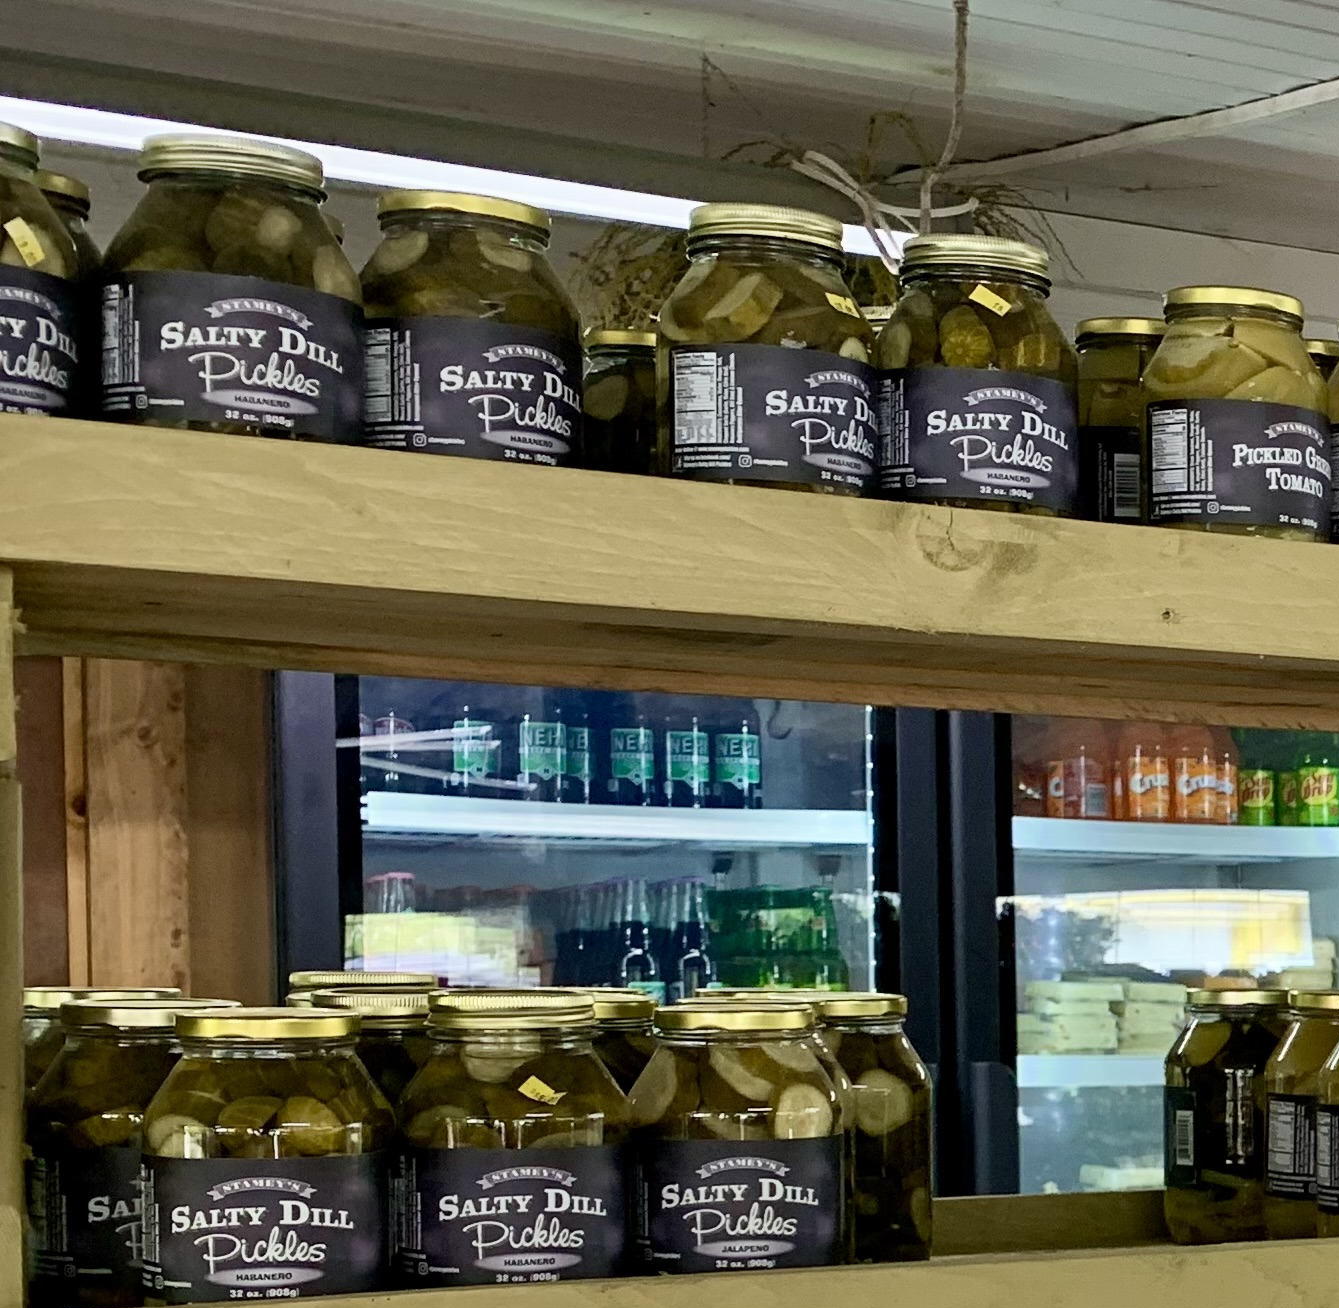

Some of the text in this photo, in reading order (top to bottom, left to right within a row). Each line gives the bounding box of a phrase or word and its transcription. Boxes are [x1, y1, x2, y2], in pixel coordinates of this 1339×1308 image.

[161, 321, 342, 374] SALTY DILL
[0, 343, 69, 390] ickles
[188, 352, 320, 397] Pickles
[440, 365, 582, 413] SALTY DILL
[765, 389, 848, 416] SALTY
[468, 394, 572, 436] Pickles
[927, 409, 1069, 450] SALTY DILL
[791, 417, 874, 459] Pickles
[949, 433, 1053, 472] Pickles
[1232, 444, 1302, 467] PICKLED
[1266, 468, 1323, 498] TOMATO
[491, 1168, 563, 1181] STAMEY'S
[709, 1158, 777, 1171] STAMEY'S
[222, 1179, 301, 1193] STAMEY'S
[661, 1177, 819, 1210] SALTY DILL
[88, 1195, 142, 1223] SAL
[171, 1200, 354, 1234] SALTY DILL
[438, 1188, 607, 1221] SALTY DILL
[462, 1213, 585, 1260] Pickles
[682, 1202, 798, 1246] Pickles
[193, 1226, 327, 1275] Pickles
[504, 1257, 556, 1266] HABANERO
[715, 1260, 728, 1268] 32
[236, 1272, 293, 1281] HABANERO
[495, 1273, 510, 1282] 32
[229, 1289, 244, 1298] 32
